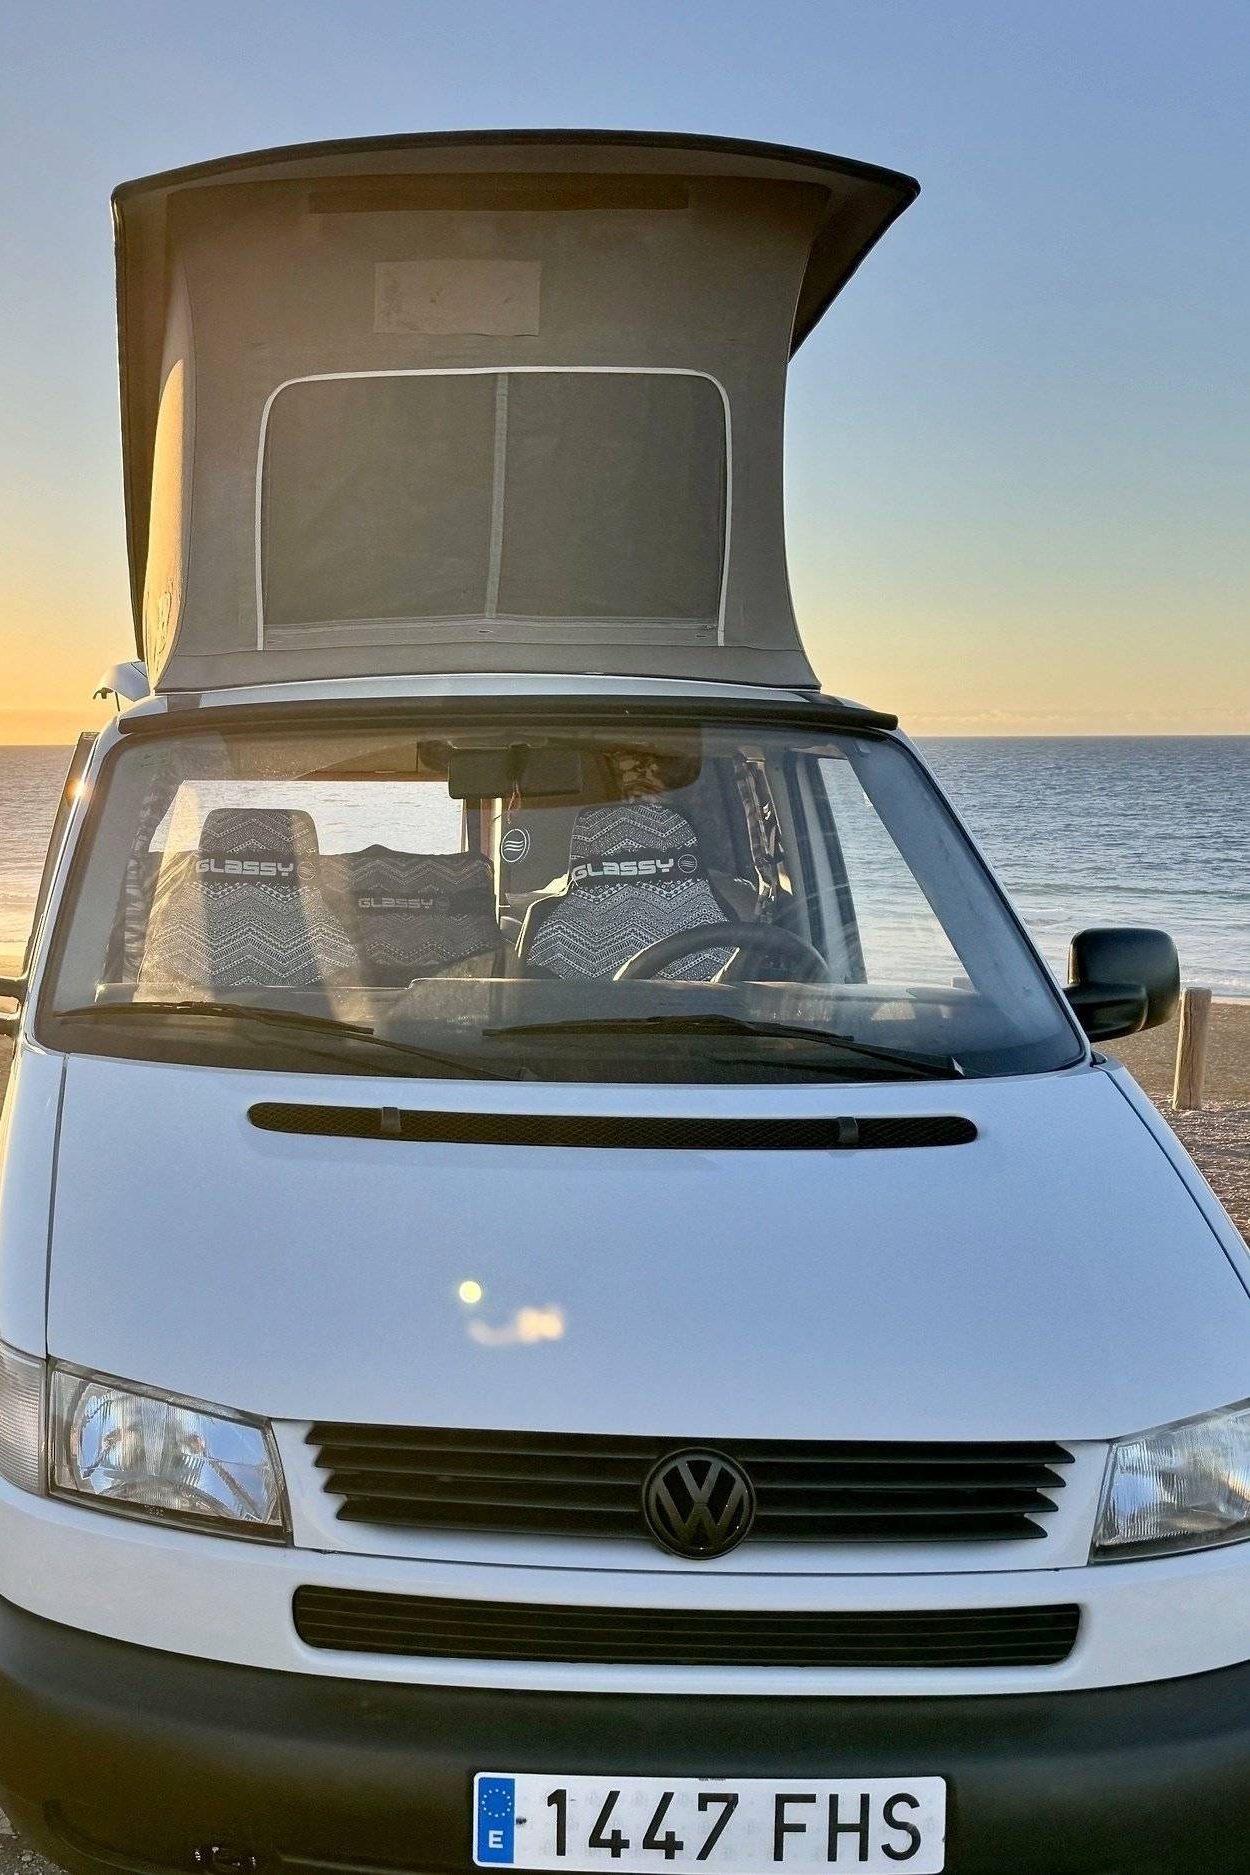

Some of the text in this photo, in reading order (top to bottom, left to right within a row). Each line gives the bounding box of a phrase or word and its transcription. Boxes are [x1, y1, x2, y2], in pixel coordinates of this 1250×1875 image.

[488, 1830, 504, 1849] E
[547, 1789, 922, 1862] 1447 FHS
